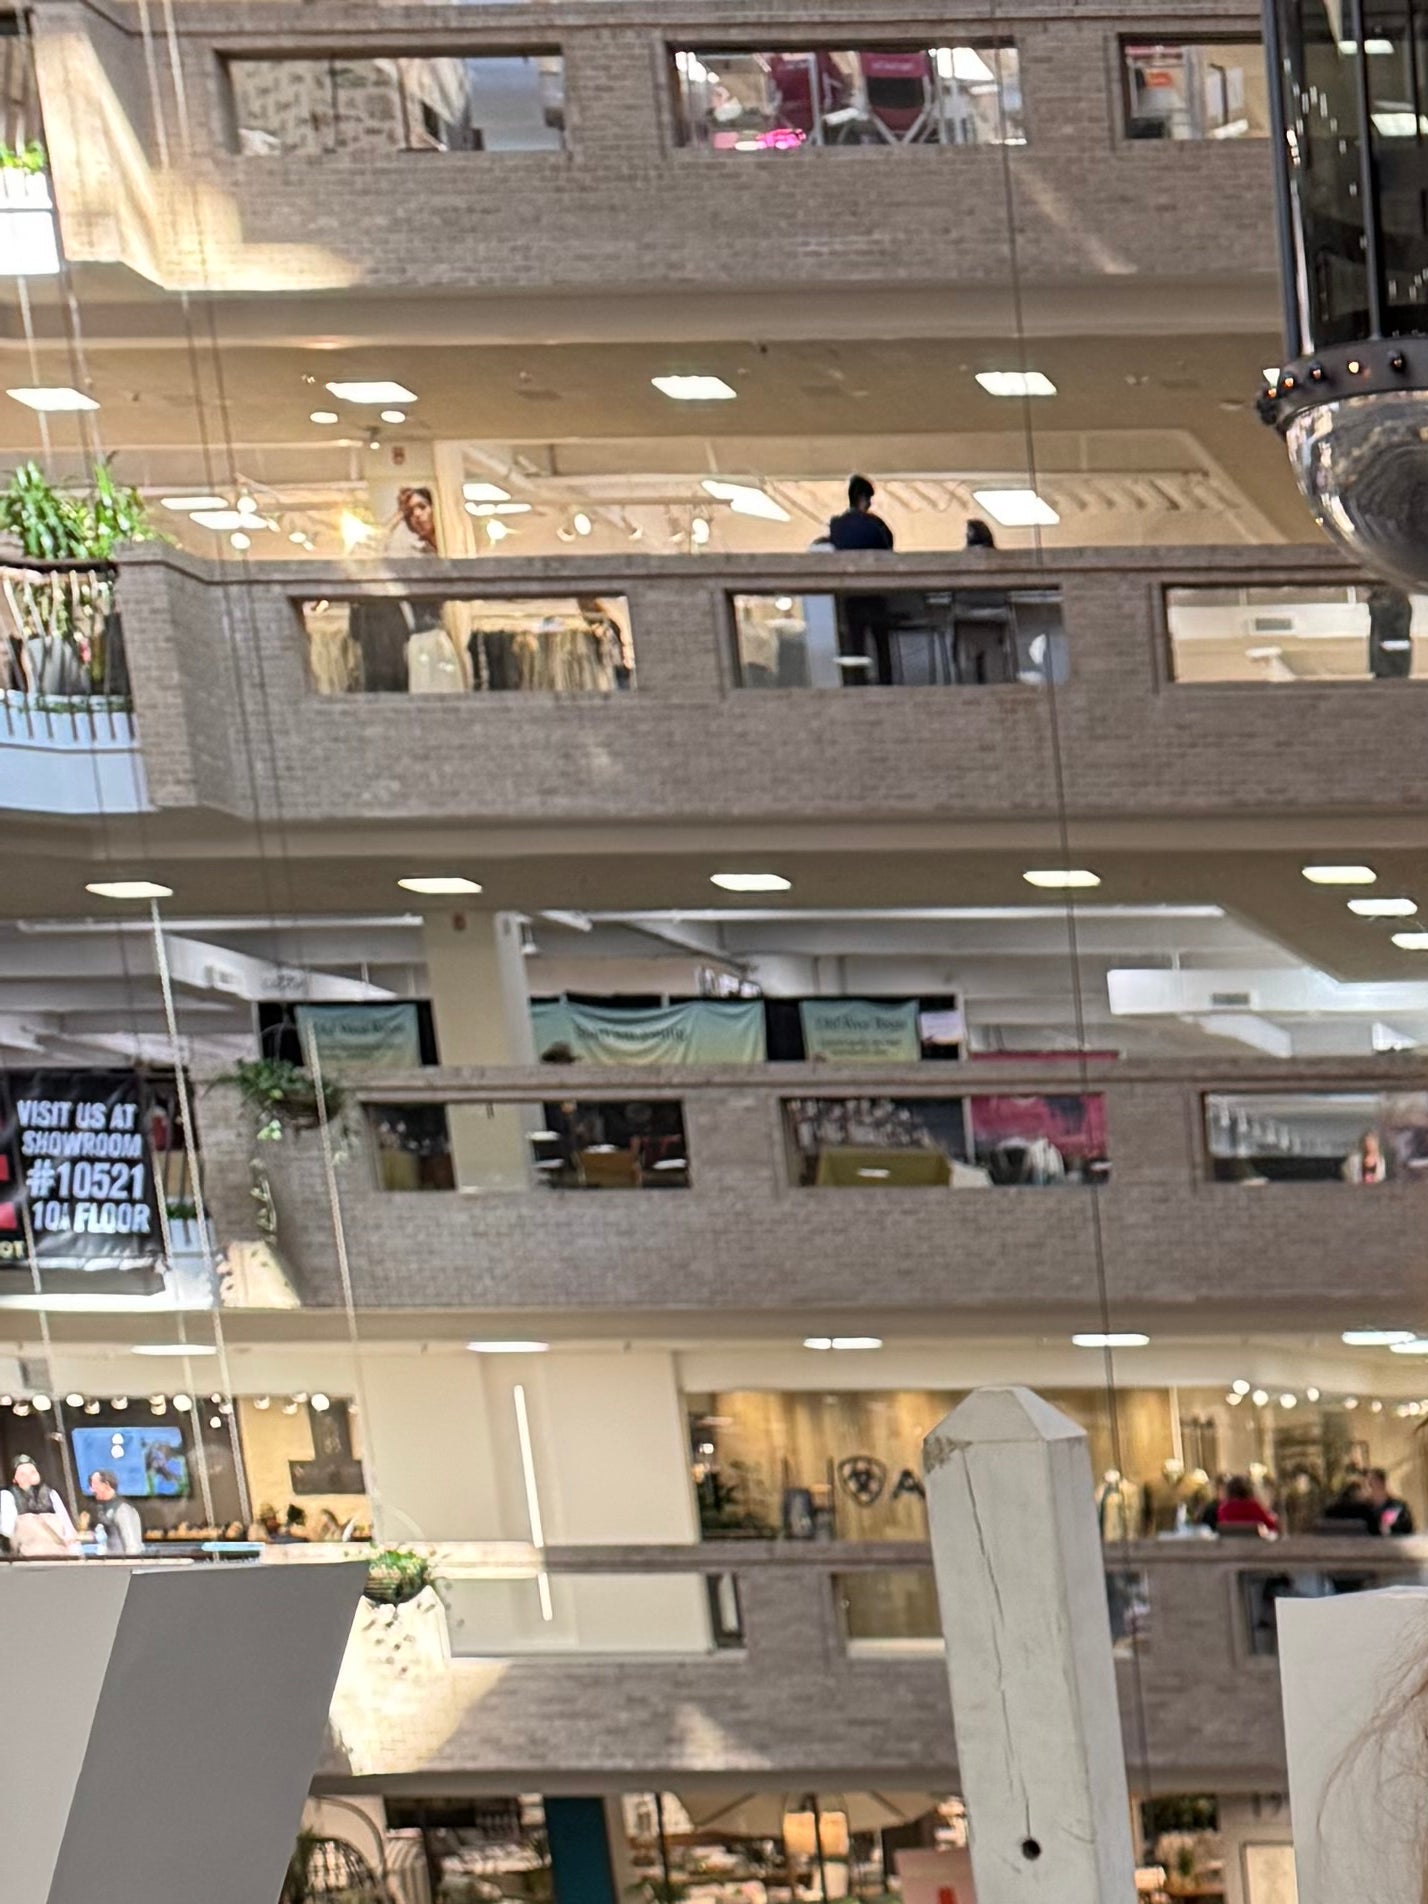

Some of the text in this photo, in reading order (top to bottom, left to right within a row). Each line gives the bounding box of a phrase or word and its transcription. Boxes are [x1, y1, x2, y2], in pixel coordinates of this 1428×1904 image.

[17, 1100, 137, 1130] VISIT US AT
[22, 1130, 142, 1158] SHOWROOM
[26, 1159, 144, 1200] #10521
[73, 1202, 150, 1233] FLOOR
